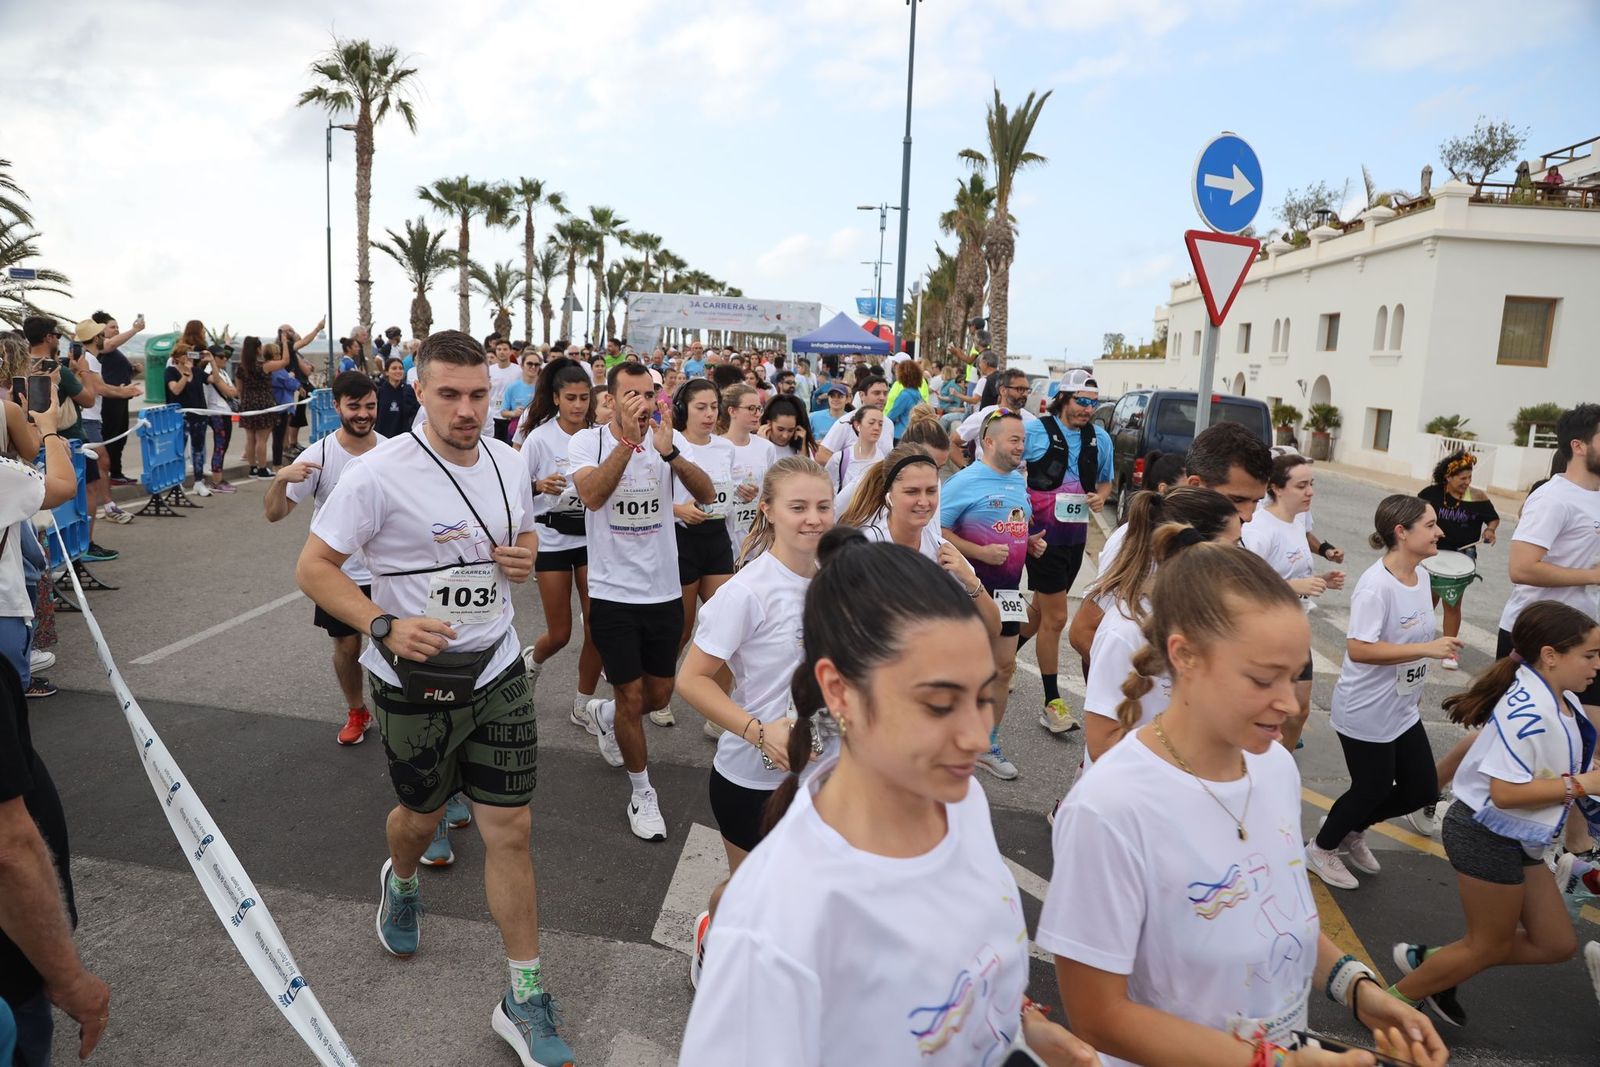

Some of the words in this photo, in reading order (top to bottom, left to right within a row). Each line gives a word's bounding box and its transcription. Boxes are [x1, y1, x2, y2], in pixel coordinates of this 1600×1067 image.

[702, 302, 745, 310] CARRERA
[746, 304, 758, 312] 5K
[616, 498, 660, 516] 1015
[1066, 504, 1082, 514] 65
[436, 582, 497, 608] 1035
[1002, 600, 1023, 612] 895
[1406, 664, 1426, 683] 540
[424, 688, 456, 701] FILA
[486, 724, 512, 742] THE
[494, 750, 512, 767] OF
